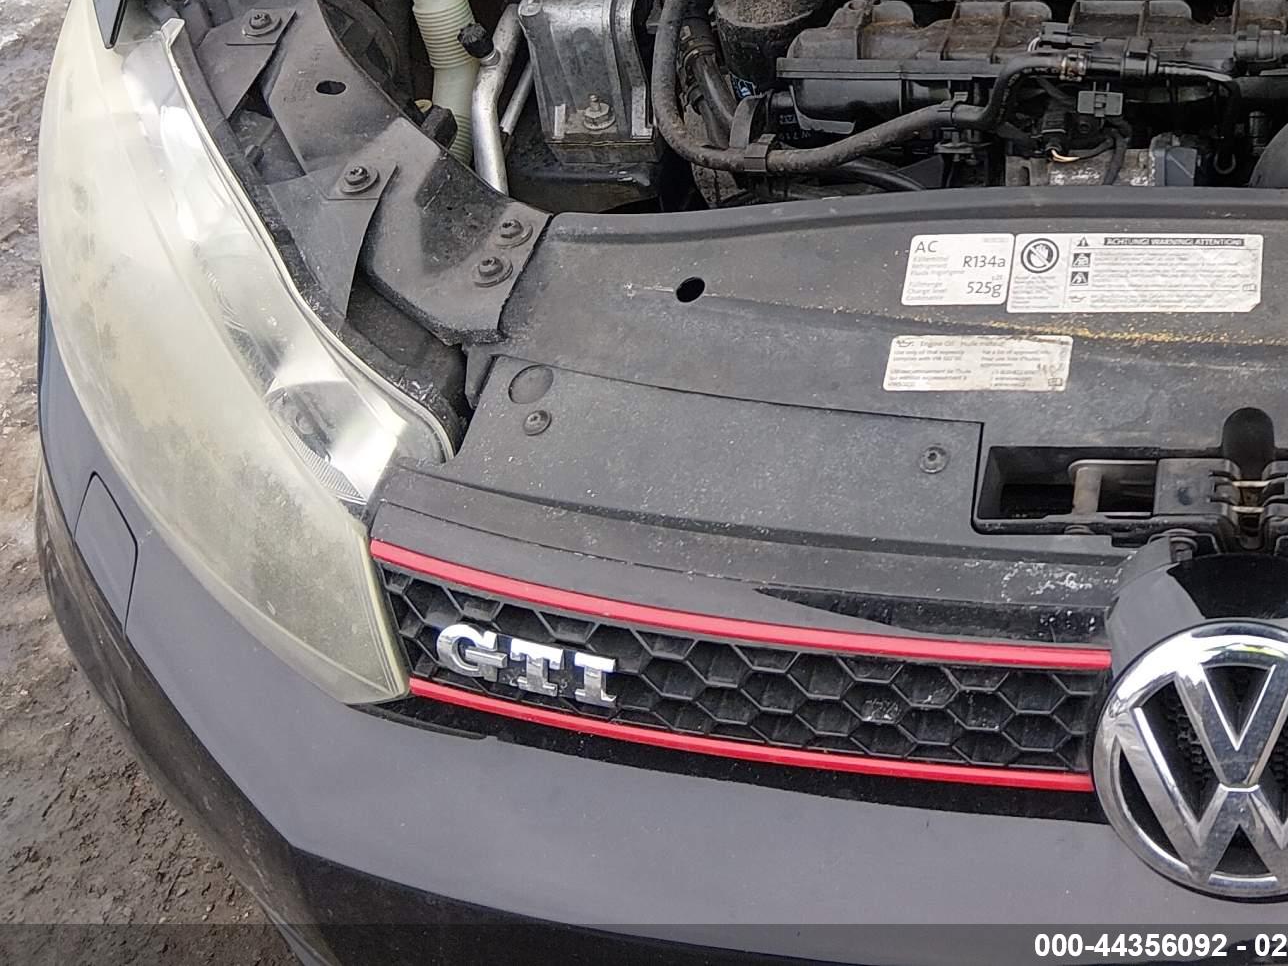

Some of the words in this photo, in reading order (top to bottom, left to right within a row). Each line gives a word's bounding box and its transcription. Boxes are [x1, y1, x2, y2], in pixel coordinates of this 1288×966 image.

[914, 240, 938, 254] AC
[962, 255, 1006, 269] R134a
[967, 281, 1002, 298] 525g
[437, 624, 618, 709] GTI
